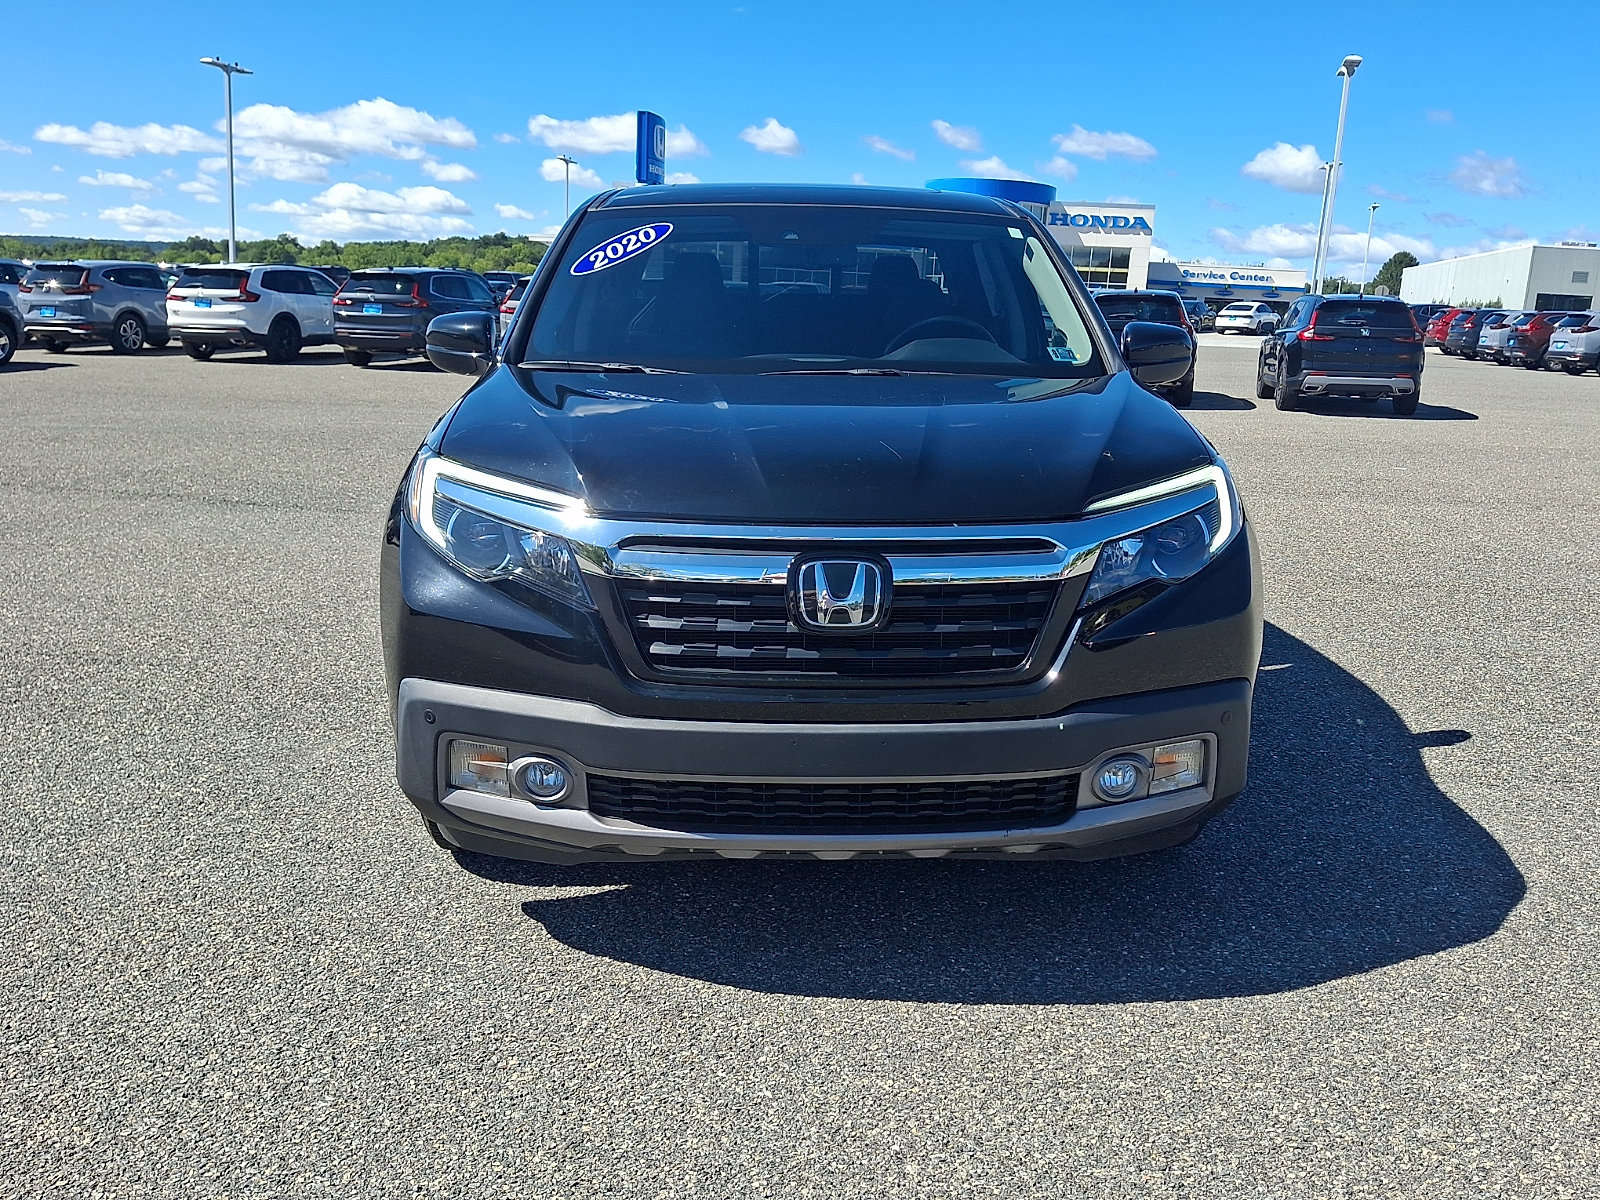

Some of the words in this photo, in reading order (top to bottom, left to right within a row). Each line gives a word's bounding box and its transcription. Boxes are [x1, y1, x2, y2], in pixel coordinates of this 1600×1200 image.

[1048, 213, 1150, 229] HONDA
[589, 227, 656, 269] 2020
[1181, 269, 1226, 280] Service
[1230, 271, 1272, 282] Center
